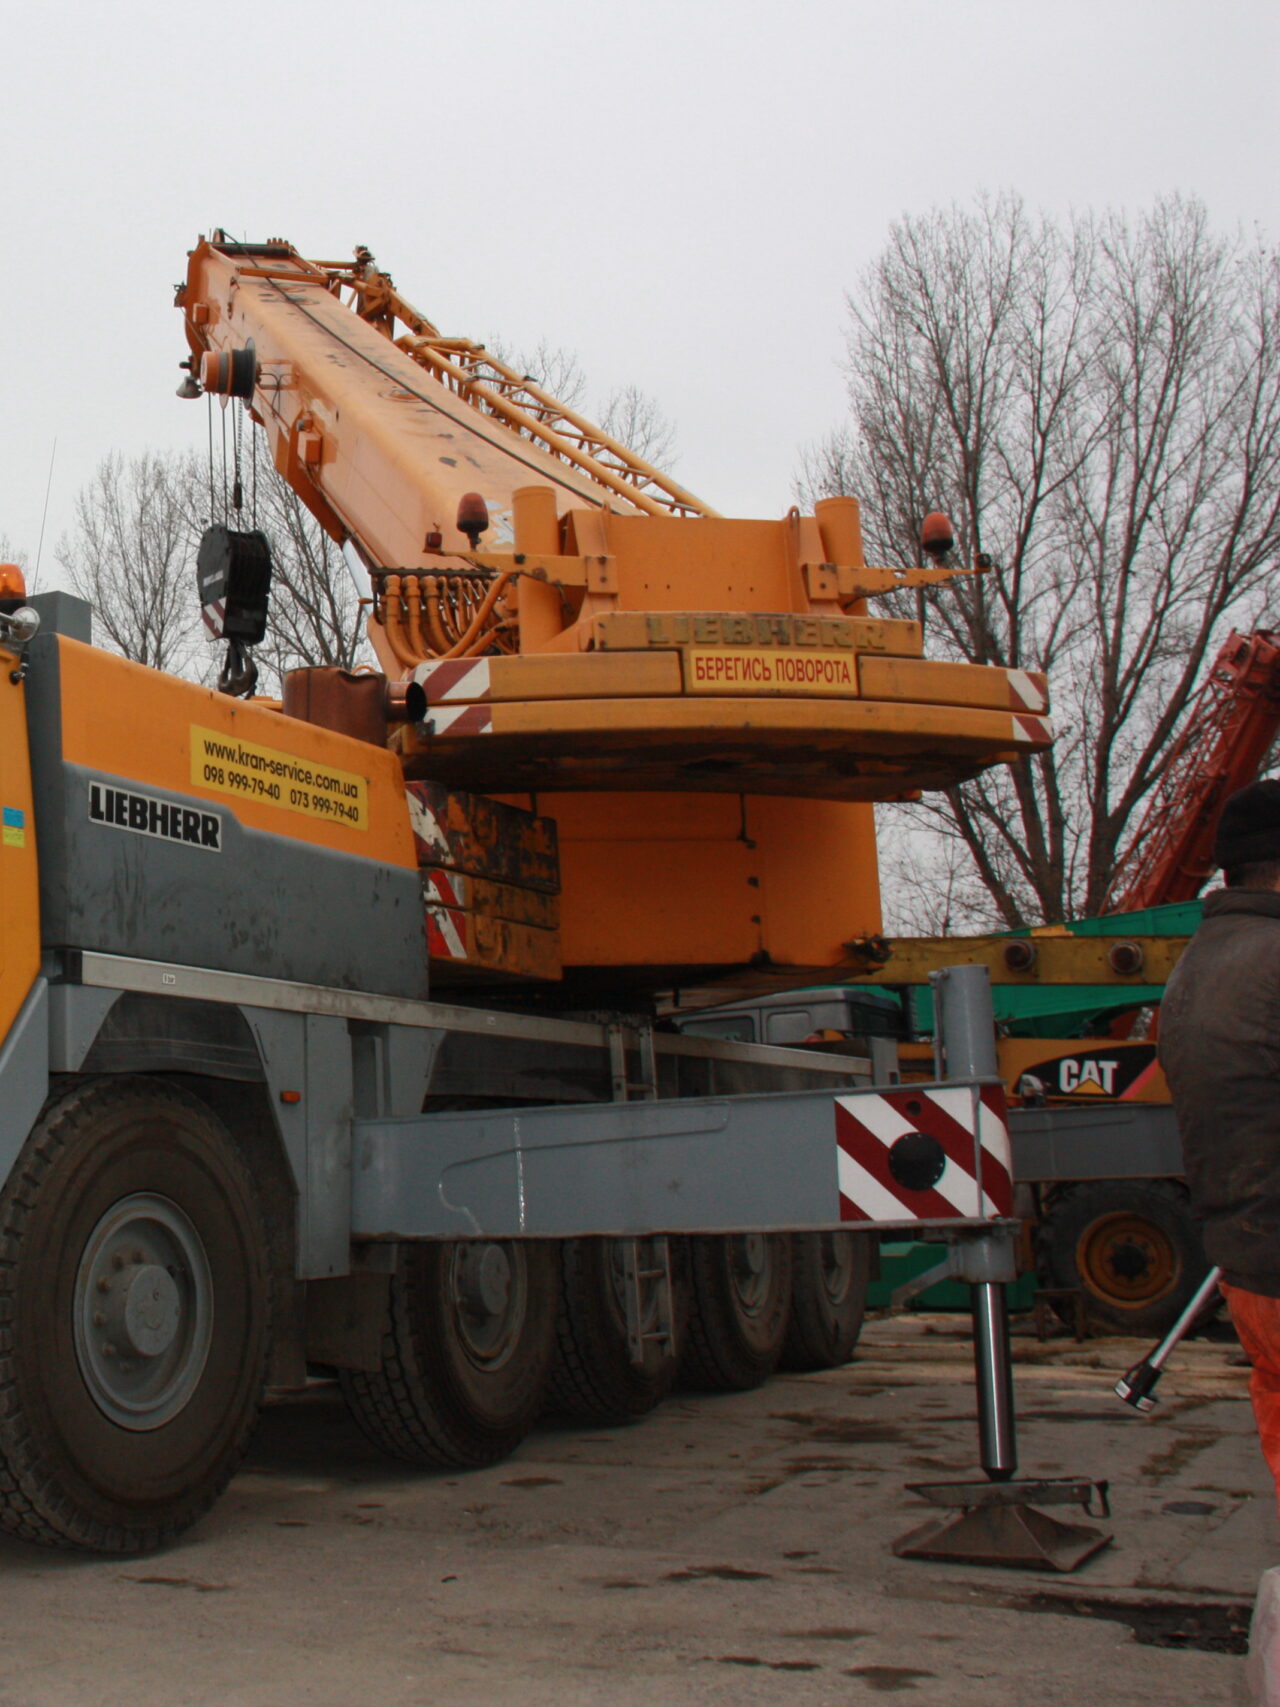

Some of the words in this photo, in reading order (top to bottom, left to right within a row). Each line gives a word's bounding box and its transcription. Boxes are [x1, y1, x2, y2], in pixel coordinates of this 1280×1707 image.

[646, 616, 886, 650] LIEBHERR
[695, 656, 771, 682] БЕРЕГИСЬ
[775, 658, 851, 684] ПОВОРОТА
[204, 739, 359, 799] www.kran-service.com.ua
[204, 764, 225, 785] 098
[228, 771, 280, 800] 999-79-40
[290, 788, 309, 808] 073
[313, 795, 359, 822] 999-79-40
[90, 785, 220, 850] LIEBHERR
[1059, 1058, 1119, 1095] CAT
